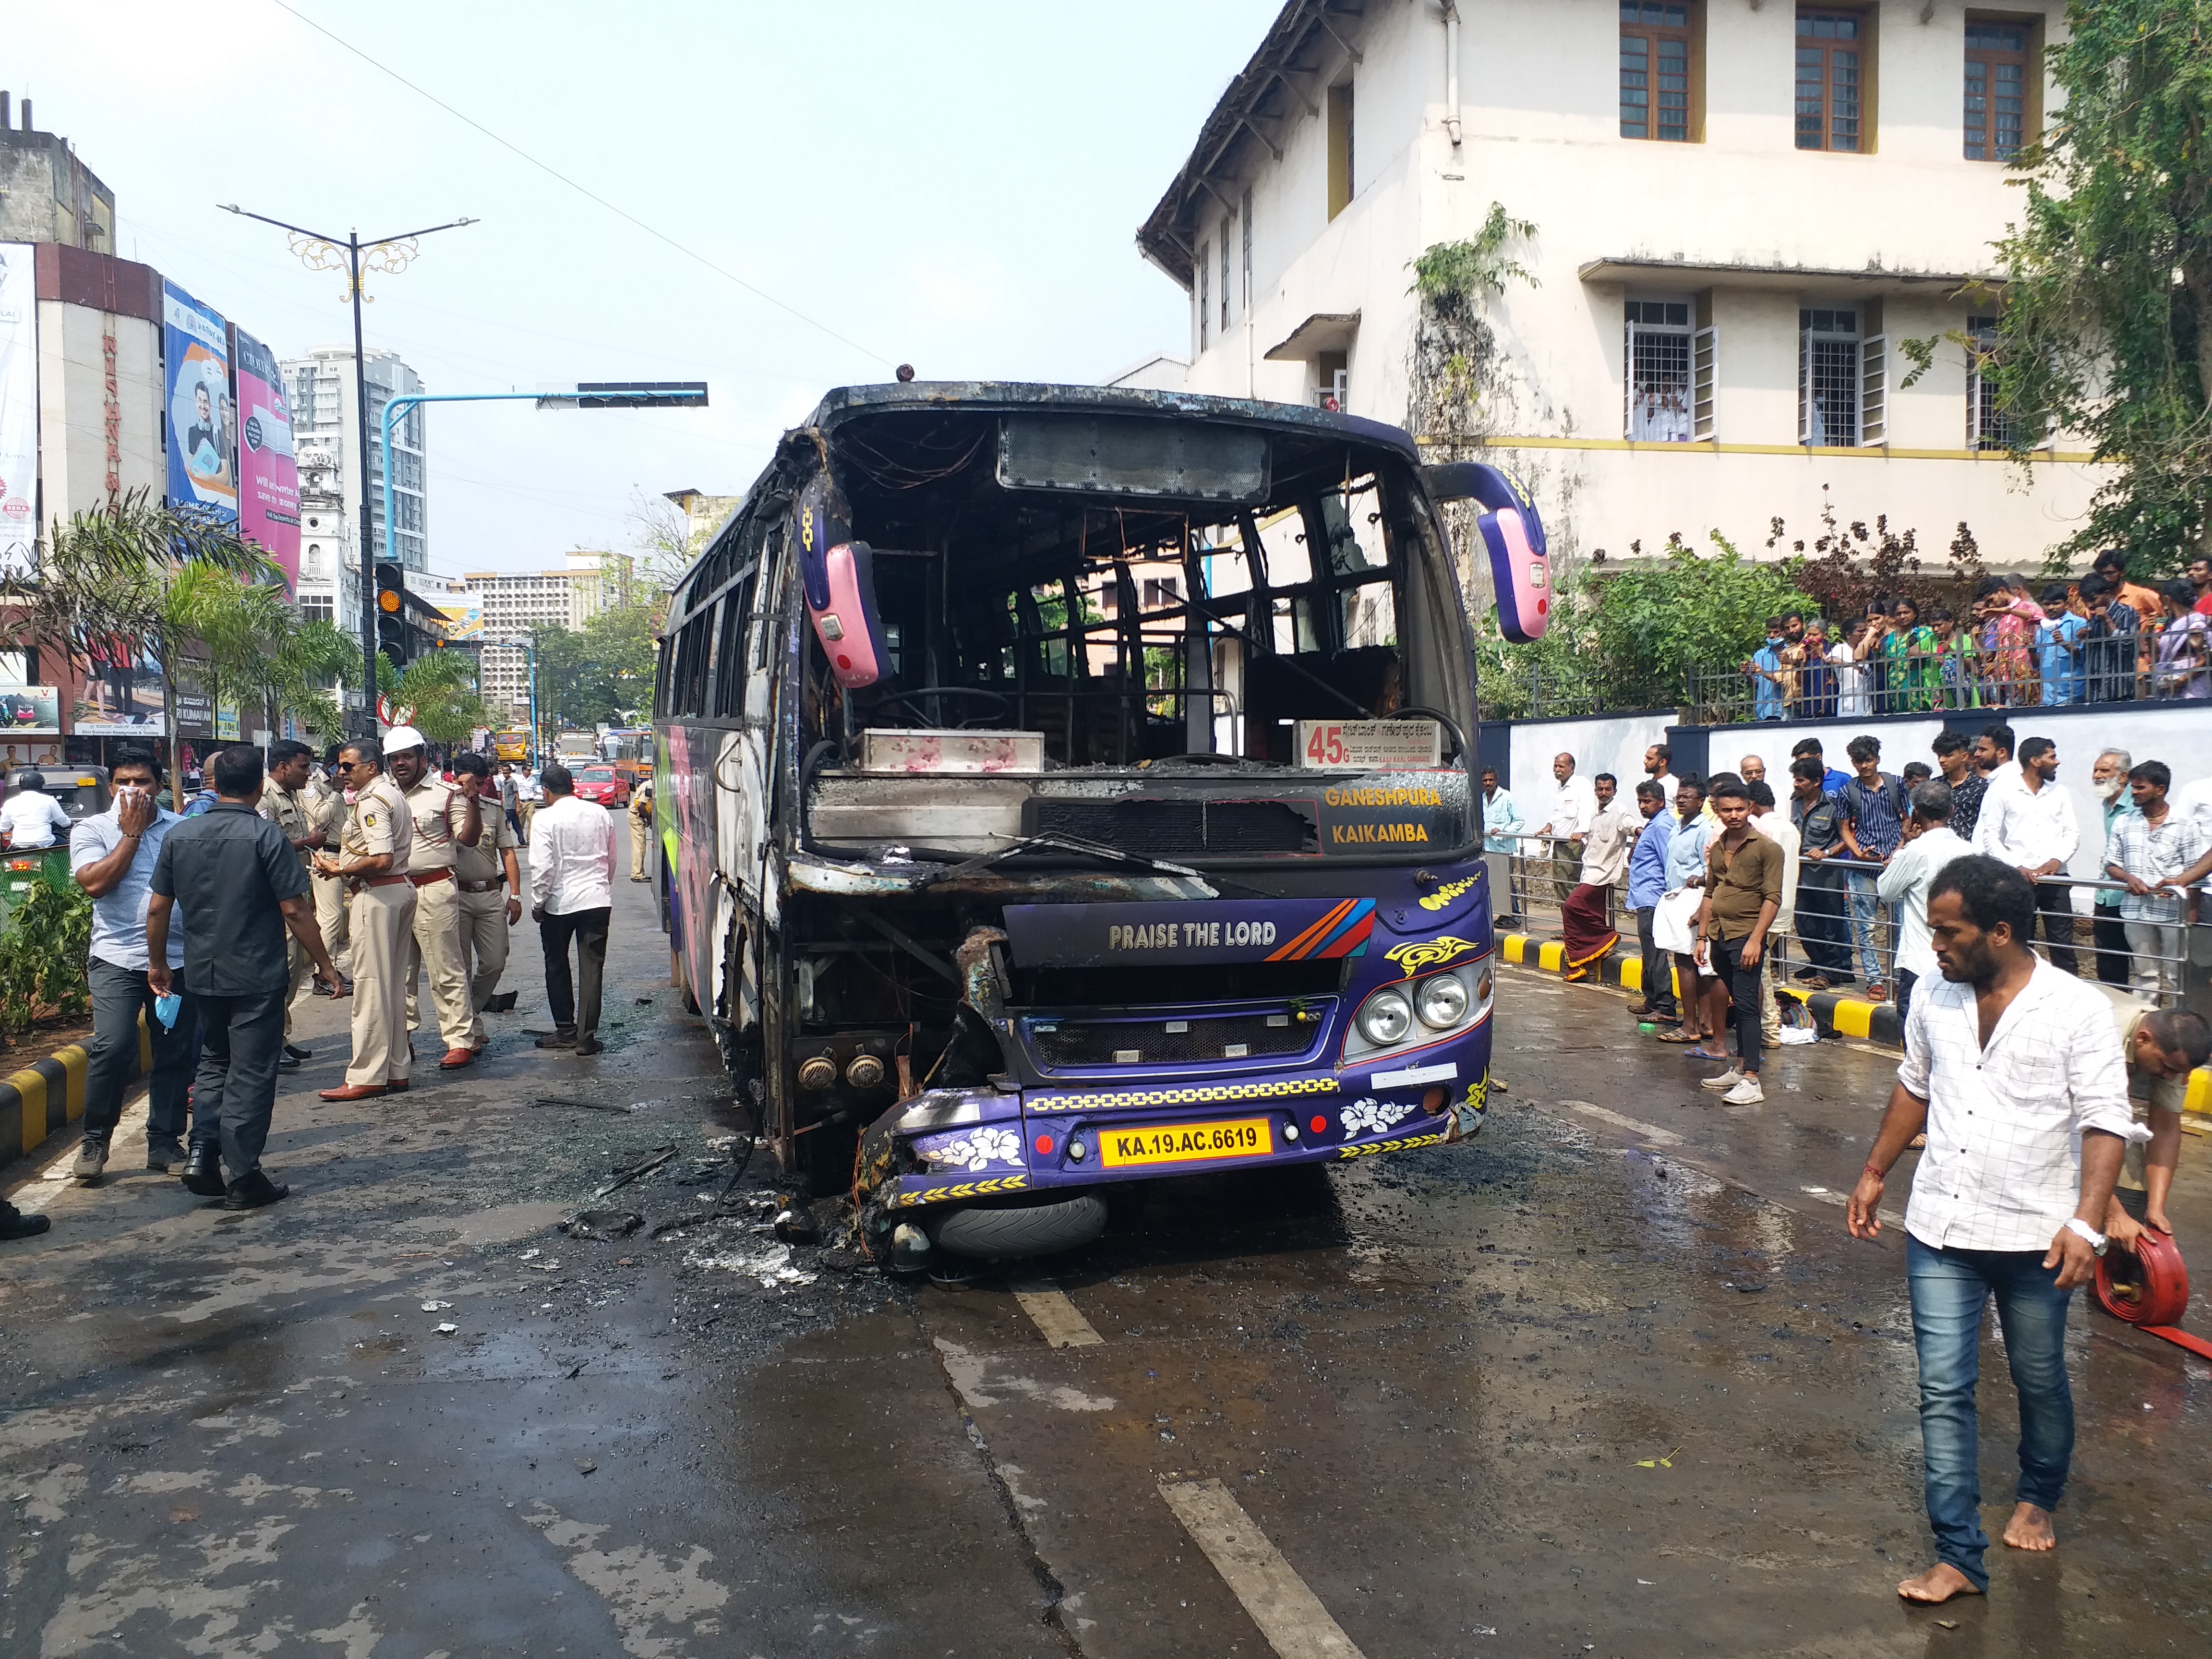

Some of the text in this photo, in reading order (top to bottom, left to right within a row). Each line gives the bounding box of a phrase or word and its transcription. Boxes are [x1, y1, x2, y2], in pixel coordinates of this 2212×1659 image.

[256, 475, 268, 488] Will
[258, 491, 270, 502] save
[279, 498, 297, 512] money
[183, 708, 211, 721] KUMARAN
[1324, 787, 1442, 807] GANESHPURA
[1332, 823, 1429, 843] KAIKAMBA
[1109, 921, 1277, 949] PRAISE THE LORD
[1117, 1127, 1257, 1157] KA.19.AC.6619
